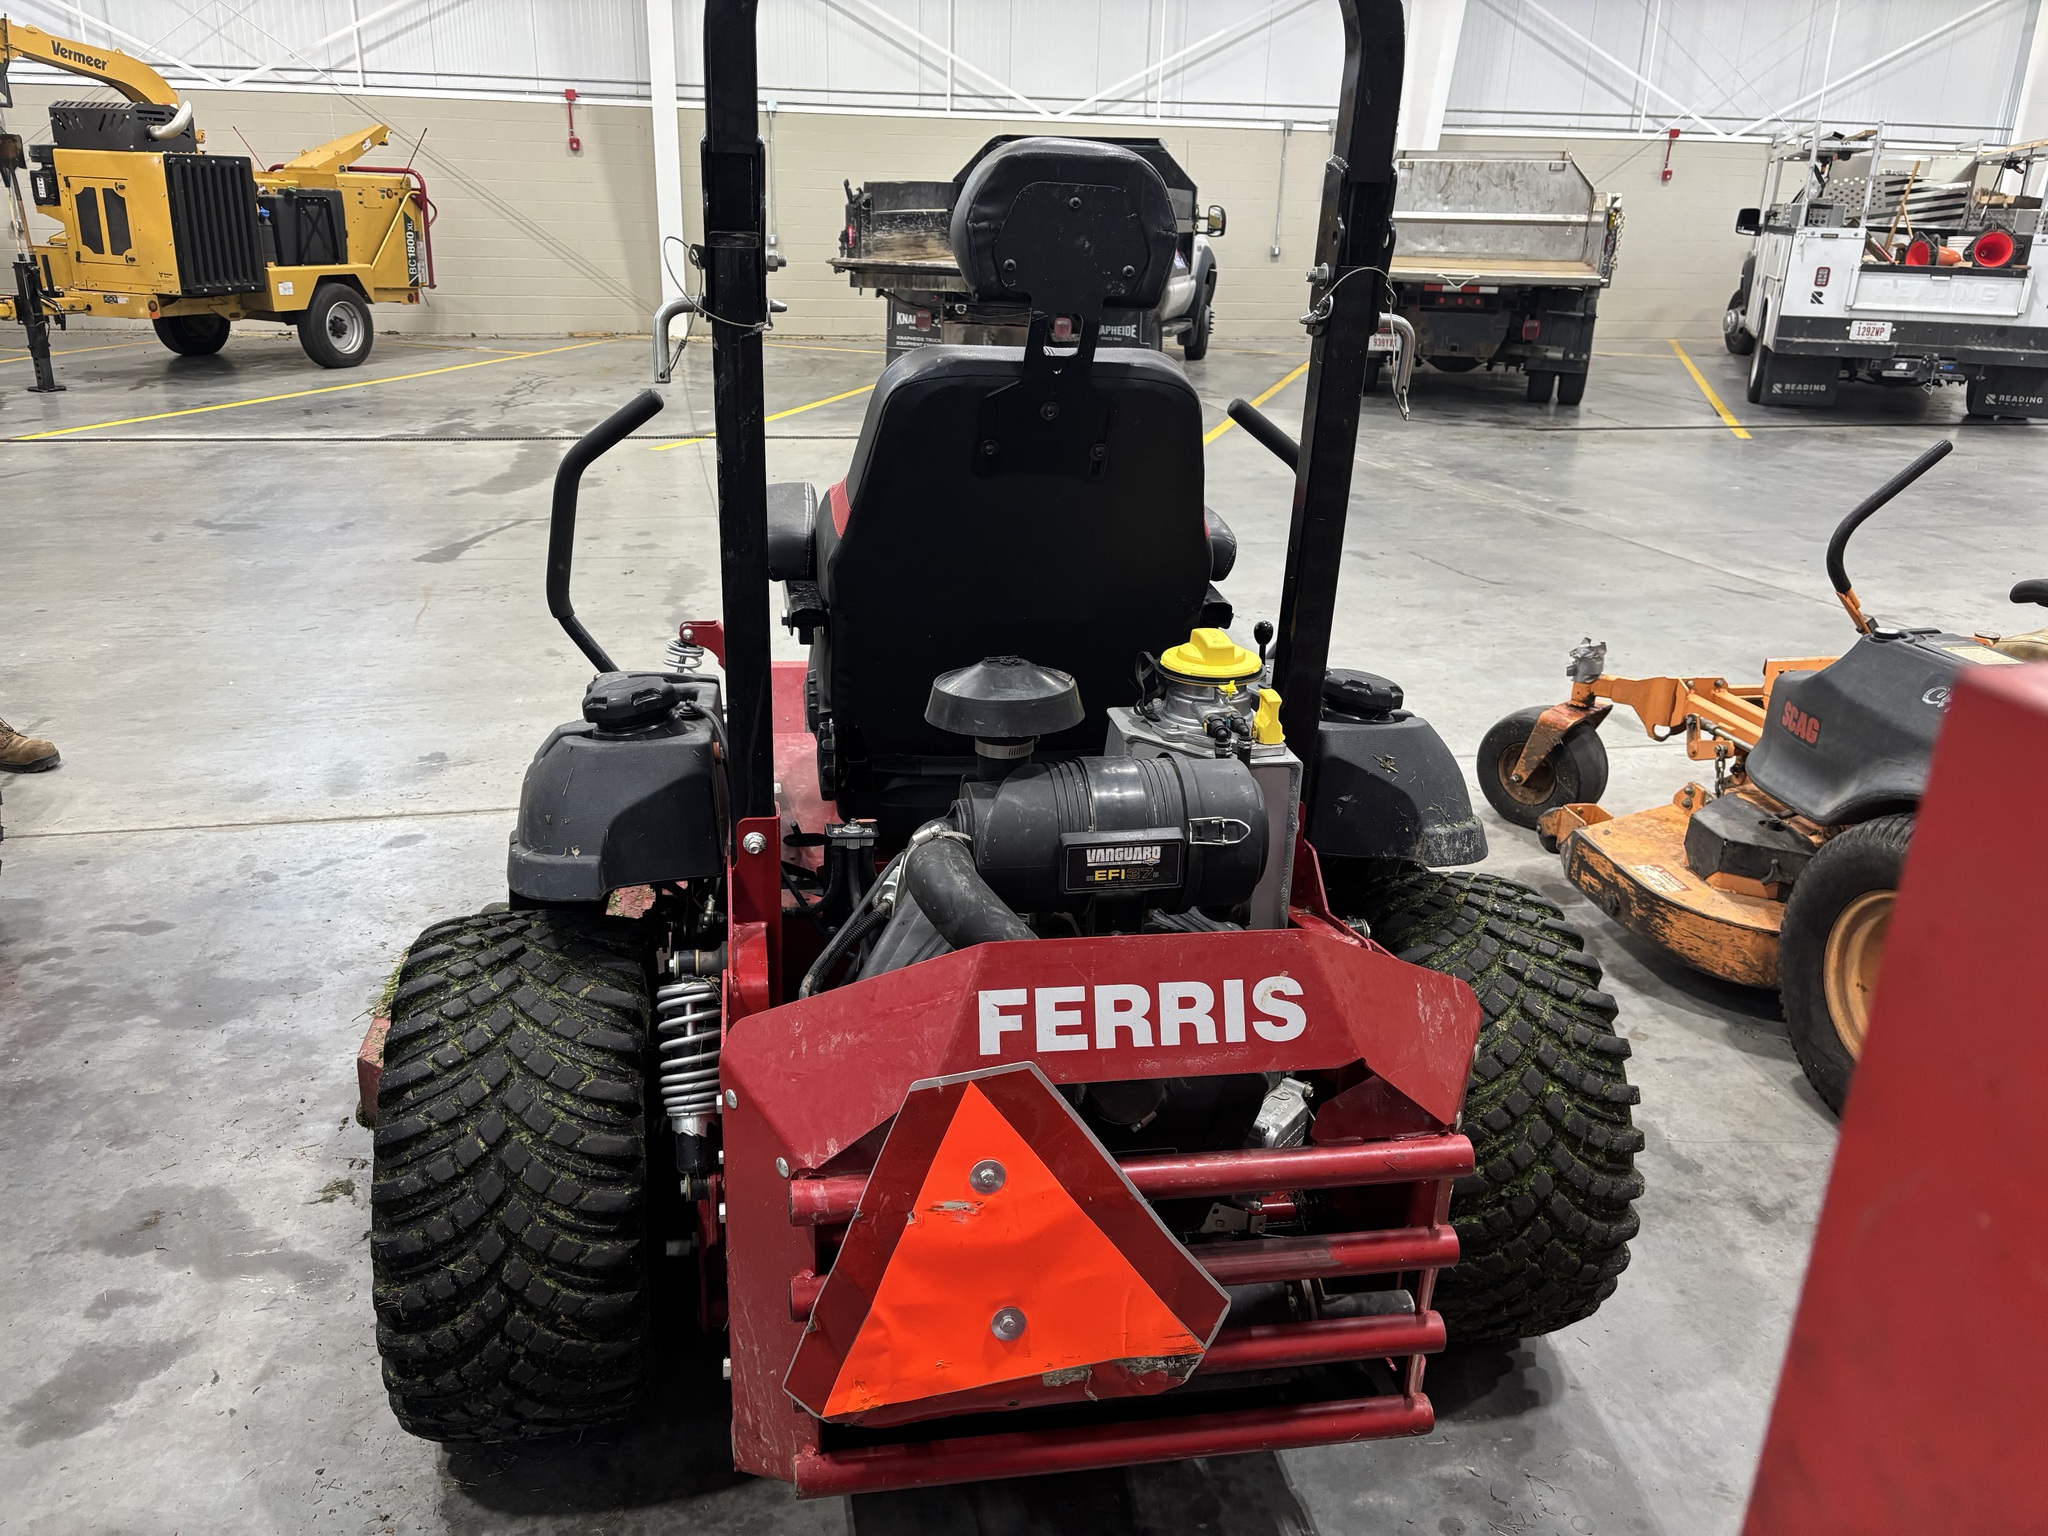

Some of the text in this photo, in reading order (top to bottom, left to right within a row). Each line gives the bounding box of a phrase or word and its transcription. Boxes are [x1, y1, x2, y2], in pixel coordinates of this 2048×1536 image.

[51, 39, 107, 71] Vermeer
[1098, 324, 1139, 339] APHEIDE
[1856, 326, 1885, 337] 129ZWP
[1784, 383, 1826, 392] READING
[1998, 394, 2043, 404] READING
[1782, 700, 1820, 744] SCAG
[1086, 846, 1161, 863] VANGUARD
[1094, 868, 1126, 881] EFI
[1126, 867, 1154, 880] 37
[978, 975, 1307, 1056] FERRIS
